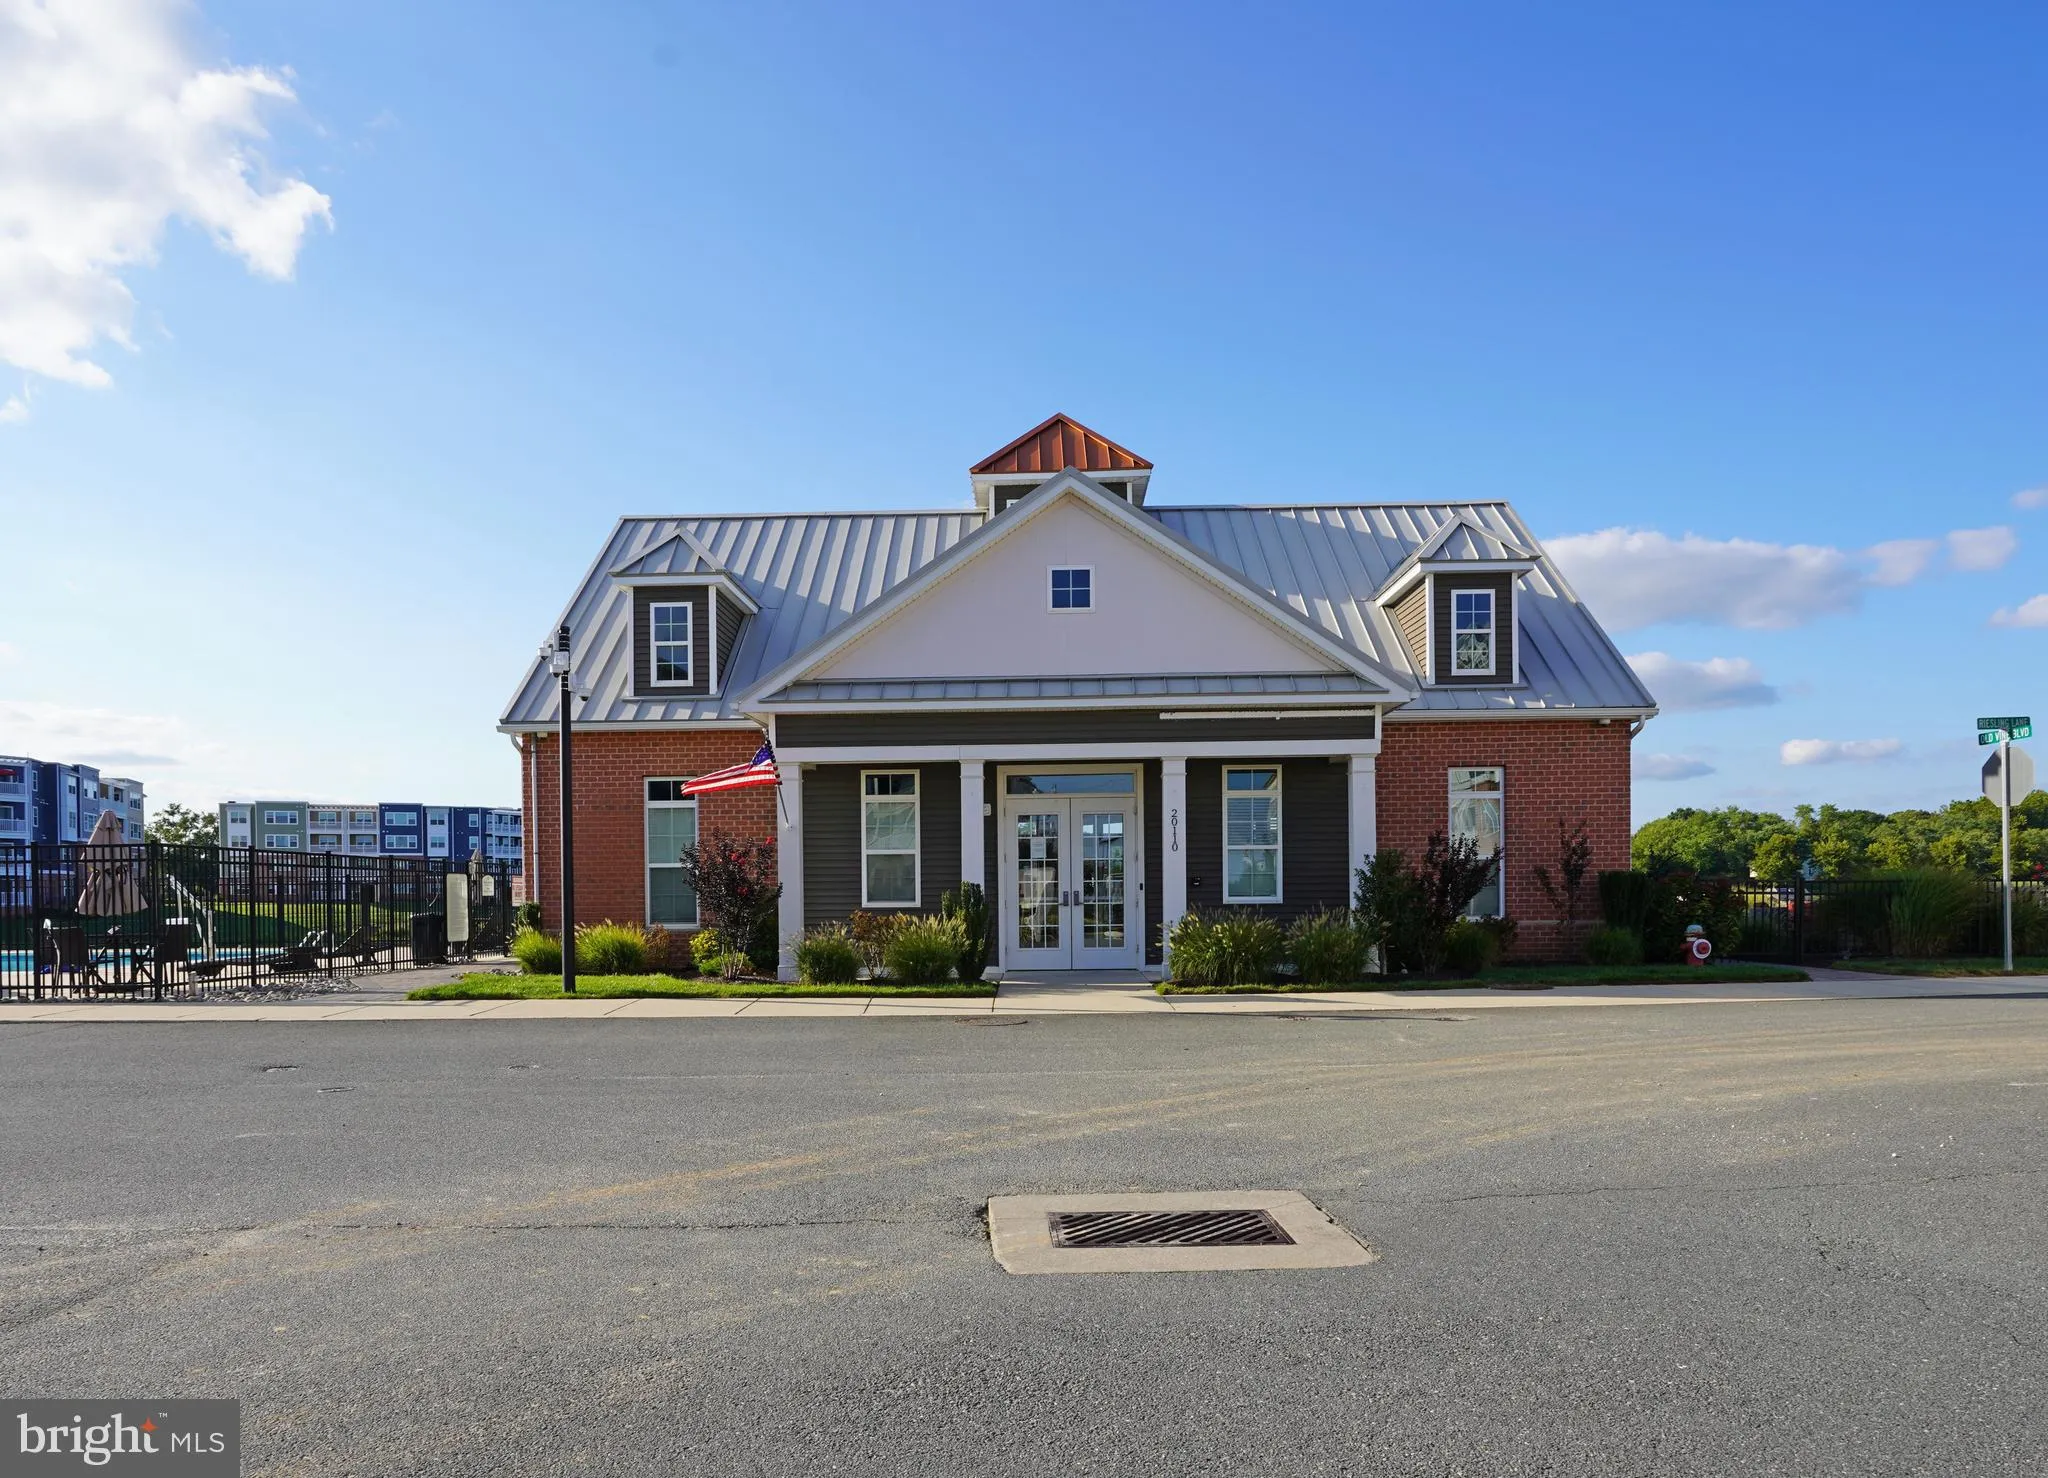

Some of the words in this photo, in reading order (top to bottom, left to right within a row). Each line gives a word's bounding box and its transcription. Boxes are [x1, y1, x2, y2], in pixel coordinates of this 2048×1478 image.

[1979, 719, 2009, 729] RIESLING
[1980, 733, 1994, 744] OLD
[2012, 727, 2030, 739] BLVD
